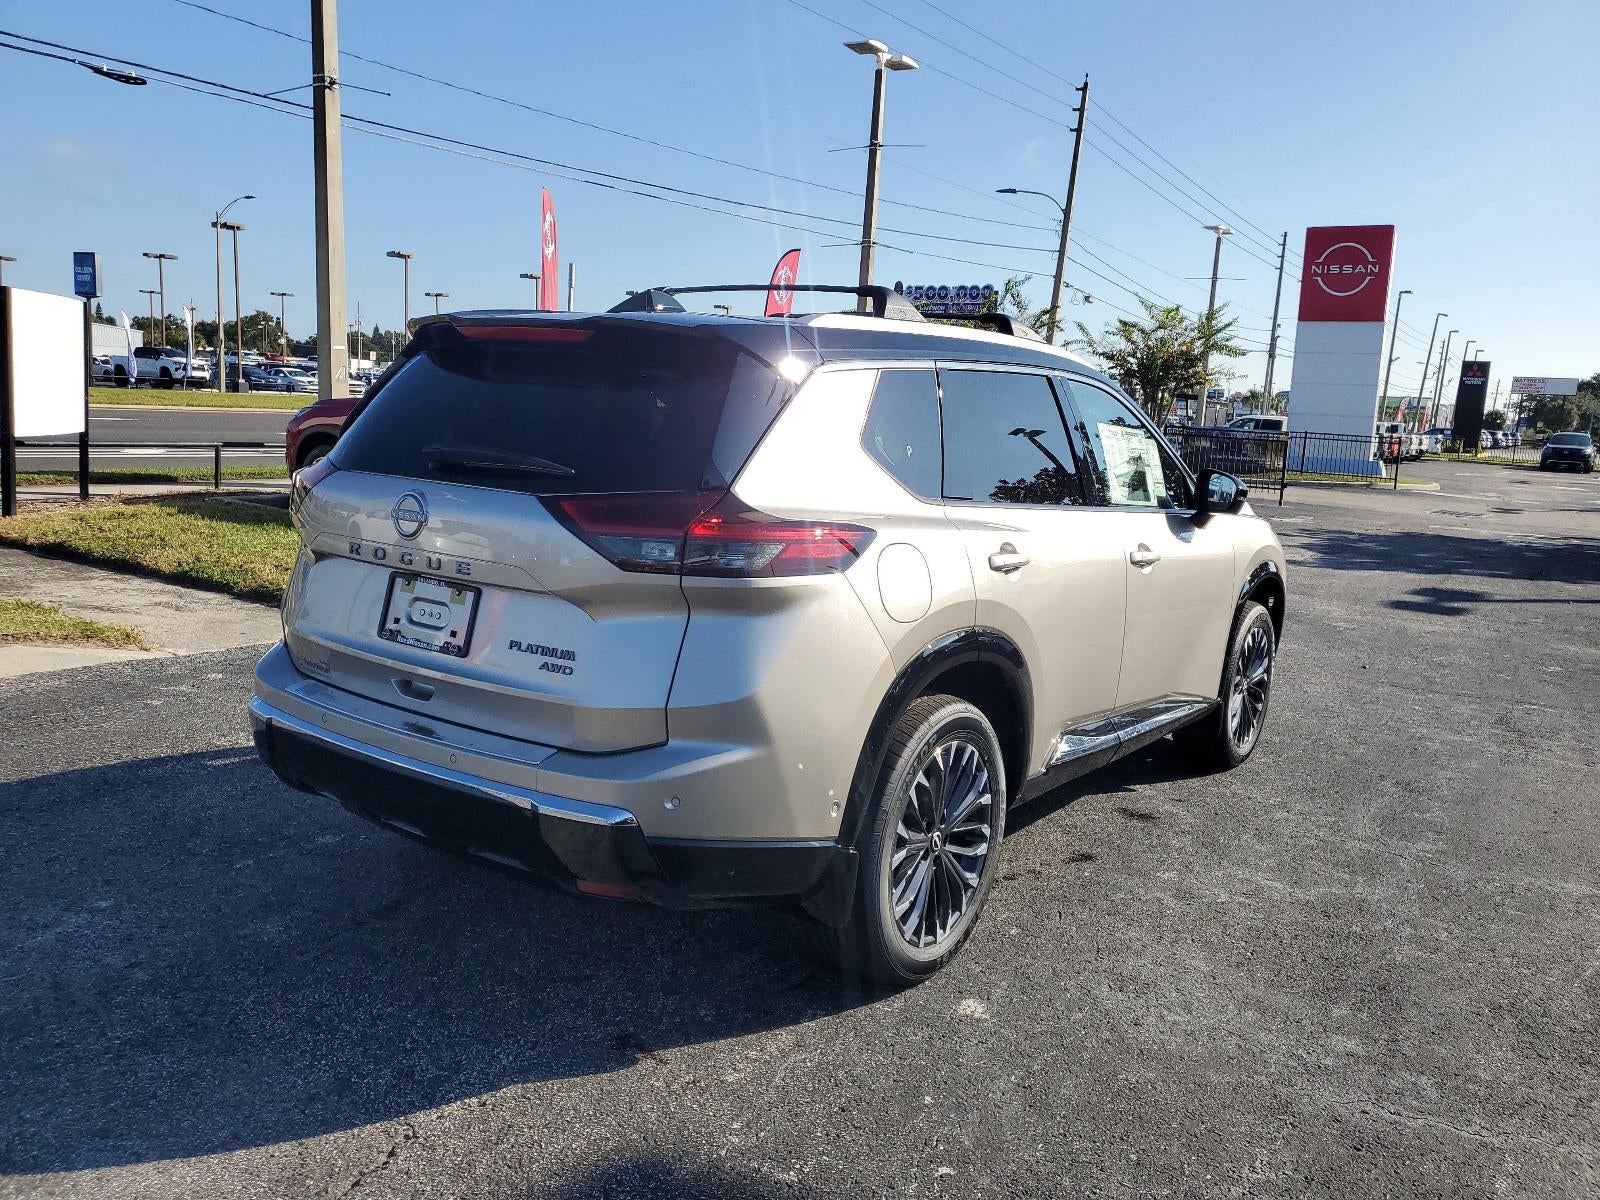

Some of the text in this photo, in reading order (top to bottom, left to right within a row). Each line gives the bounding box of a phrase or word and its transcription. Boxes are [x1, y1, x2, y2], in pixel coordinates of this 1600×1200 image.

[1311, 264, 1379, 274] NISSAN
[905, 283, 994, 304] $500,000
[348, 541, 472, 576] ROGUE
[508, 639, 576, 662] PLATINUM
[538, 661, 574, 676] AWD
